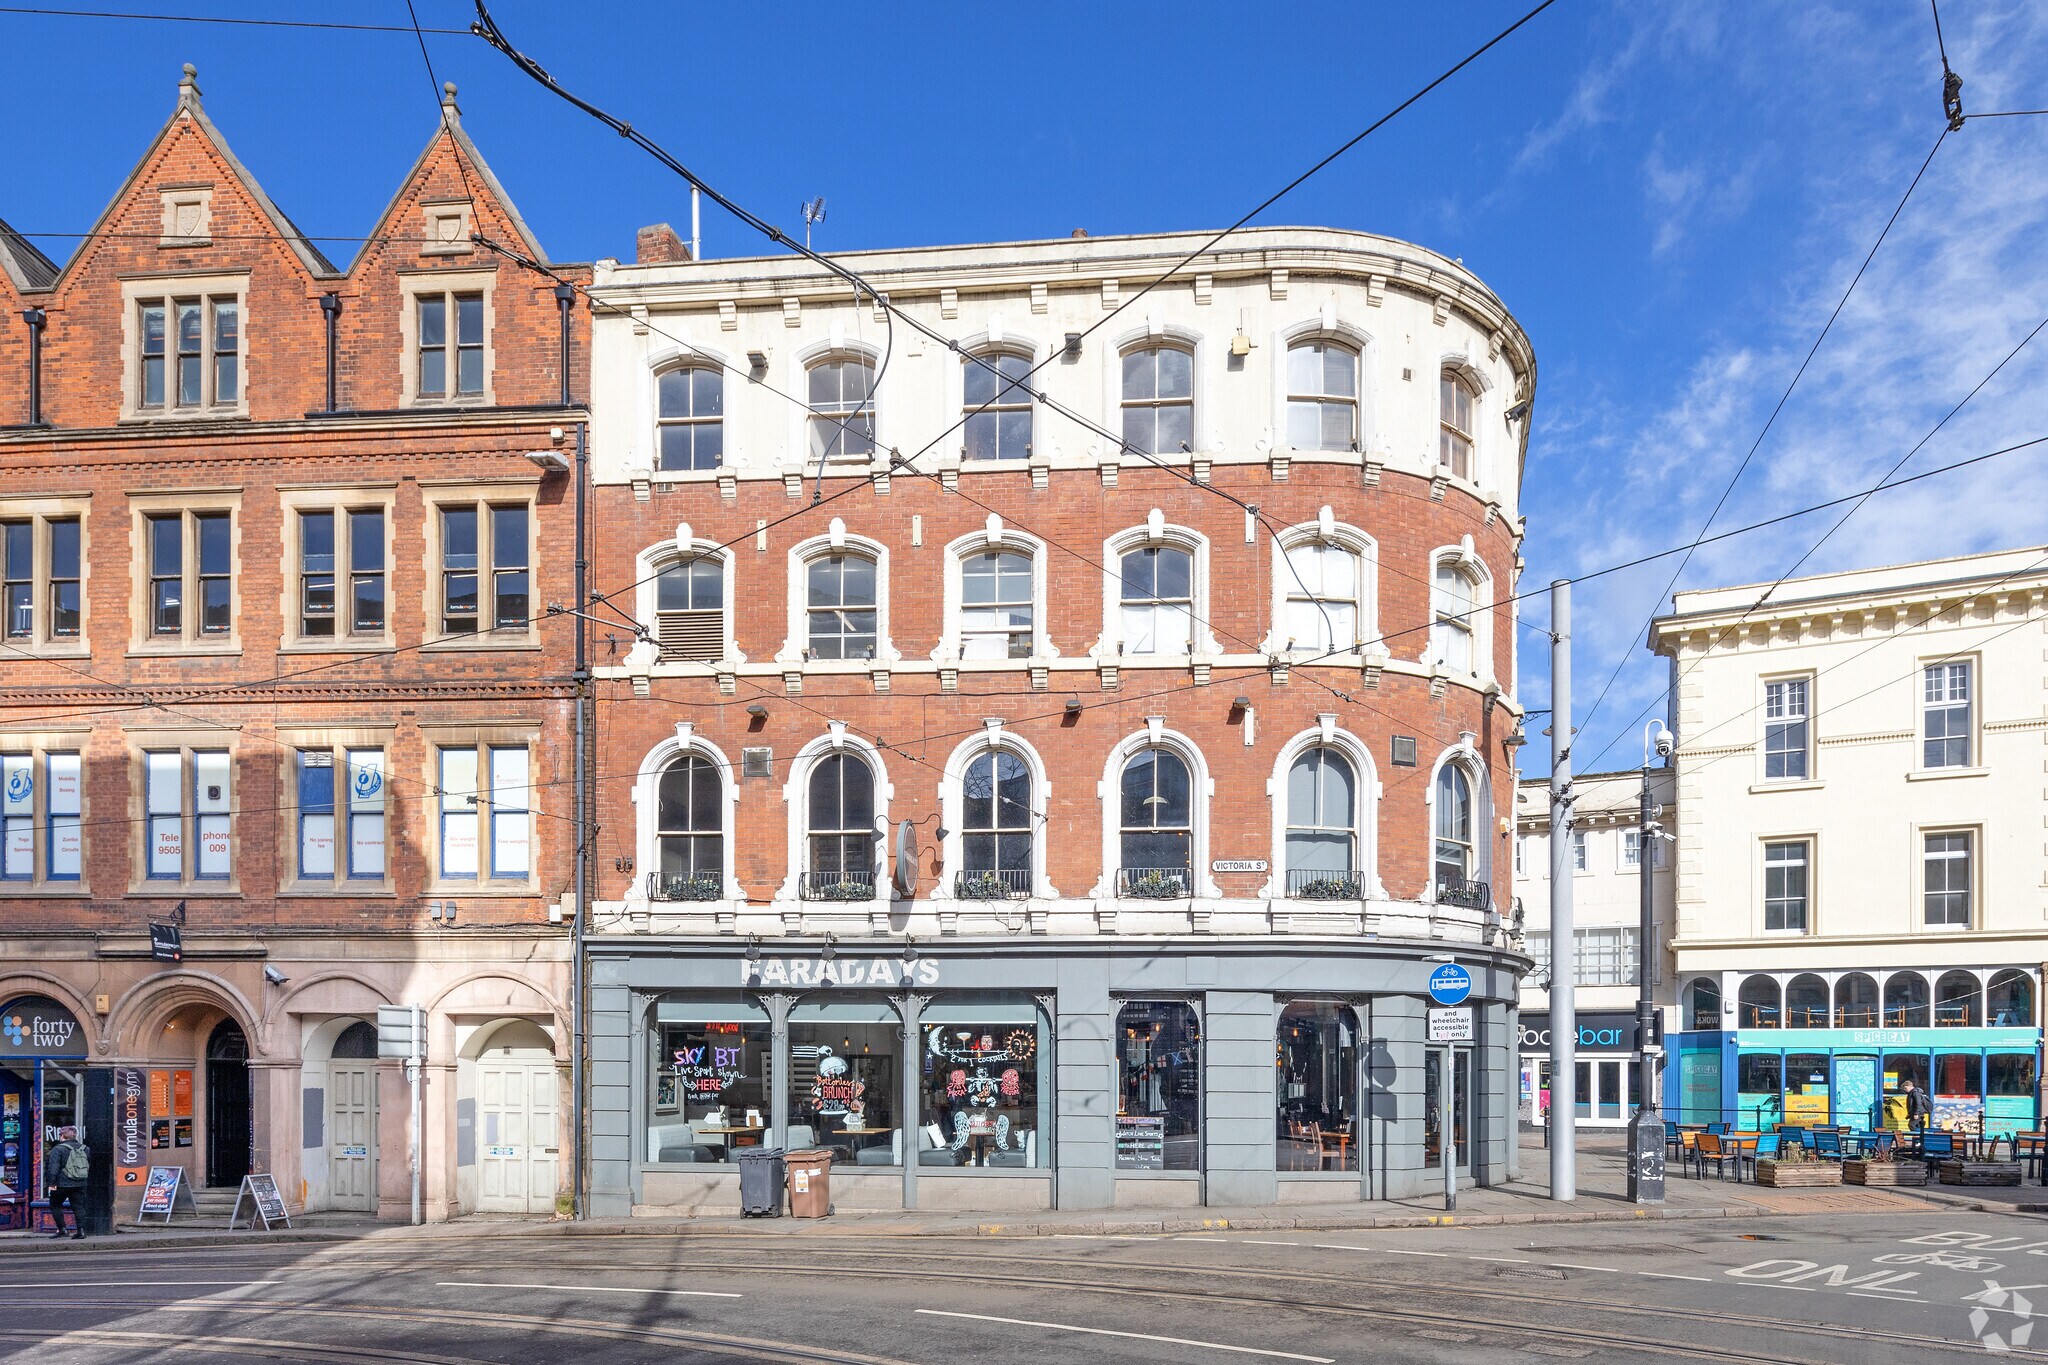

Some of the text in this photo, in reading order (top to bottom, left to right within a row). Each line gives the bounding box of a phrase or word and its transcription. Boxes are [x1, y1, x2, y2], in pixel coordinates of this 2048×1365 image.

[160, 833, 179, 842] Tele
[158, 846, 181, 855] 9505
[209, 844, 227, 853] 009
[1215, 862, 1252, 870] VICTORIA
[740, 956, 940, 985] FARADAYS
[33, 1016, 76, 1039] forty
[33, 1032, 65, 1047] two
[1854, 1031, 1910, 1043] SPICE CAY
[673, 1045, 741, 1067] SKY BT
[673, 1065, 693, 1076] Live
[696, 1078, 721, 1091] HERE
[822, 1085, 854, 1099] BRUNCH
[123, 1071, 141, 1164] formulaonegym
[149, 1189, 165, 1197] £22
[261, 1203, 273, 1211] £22
